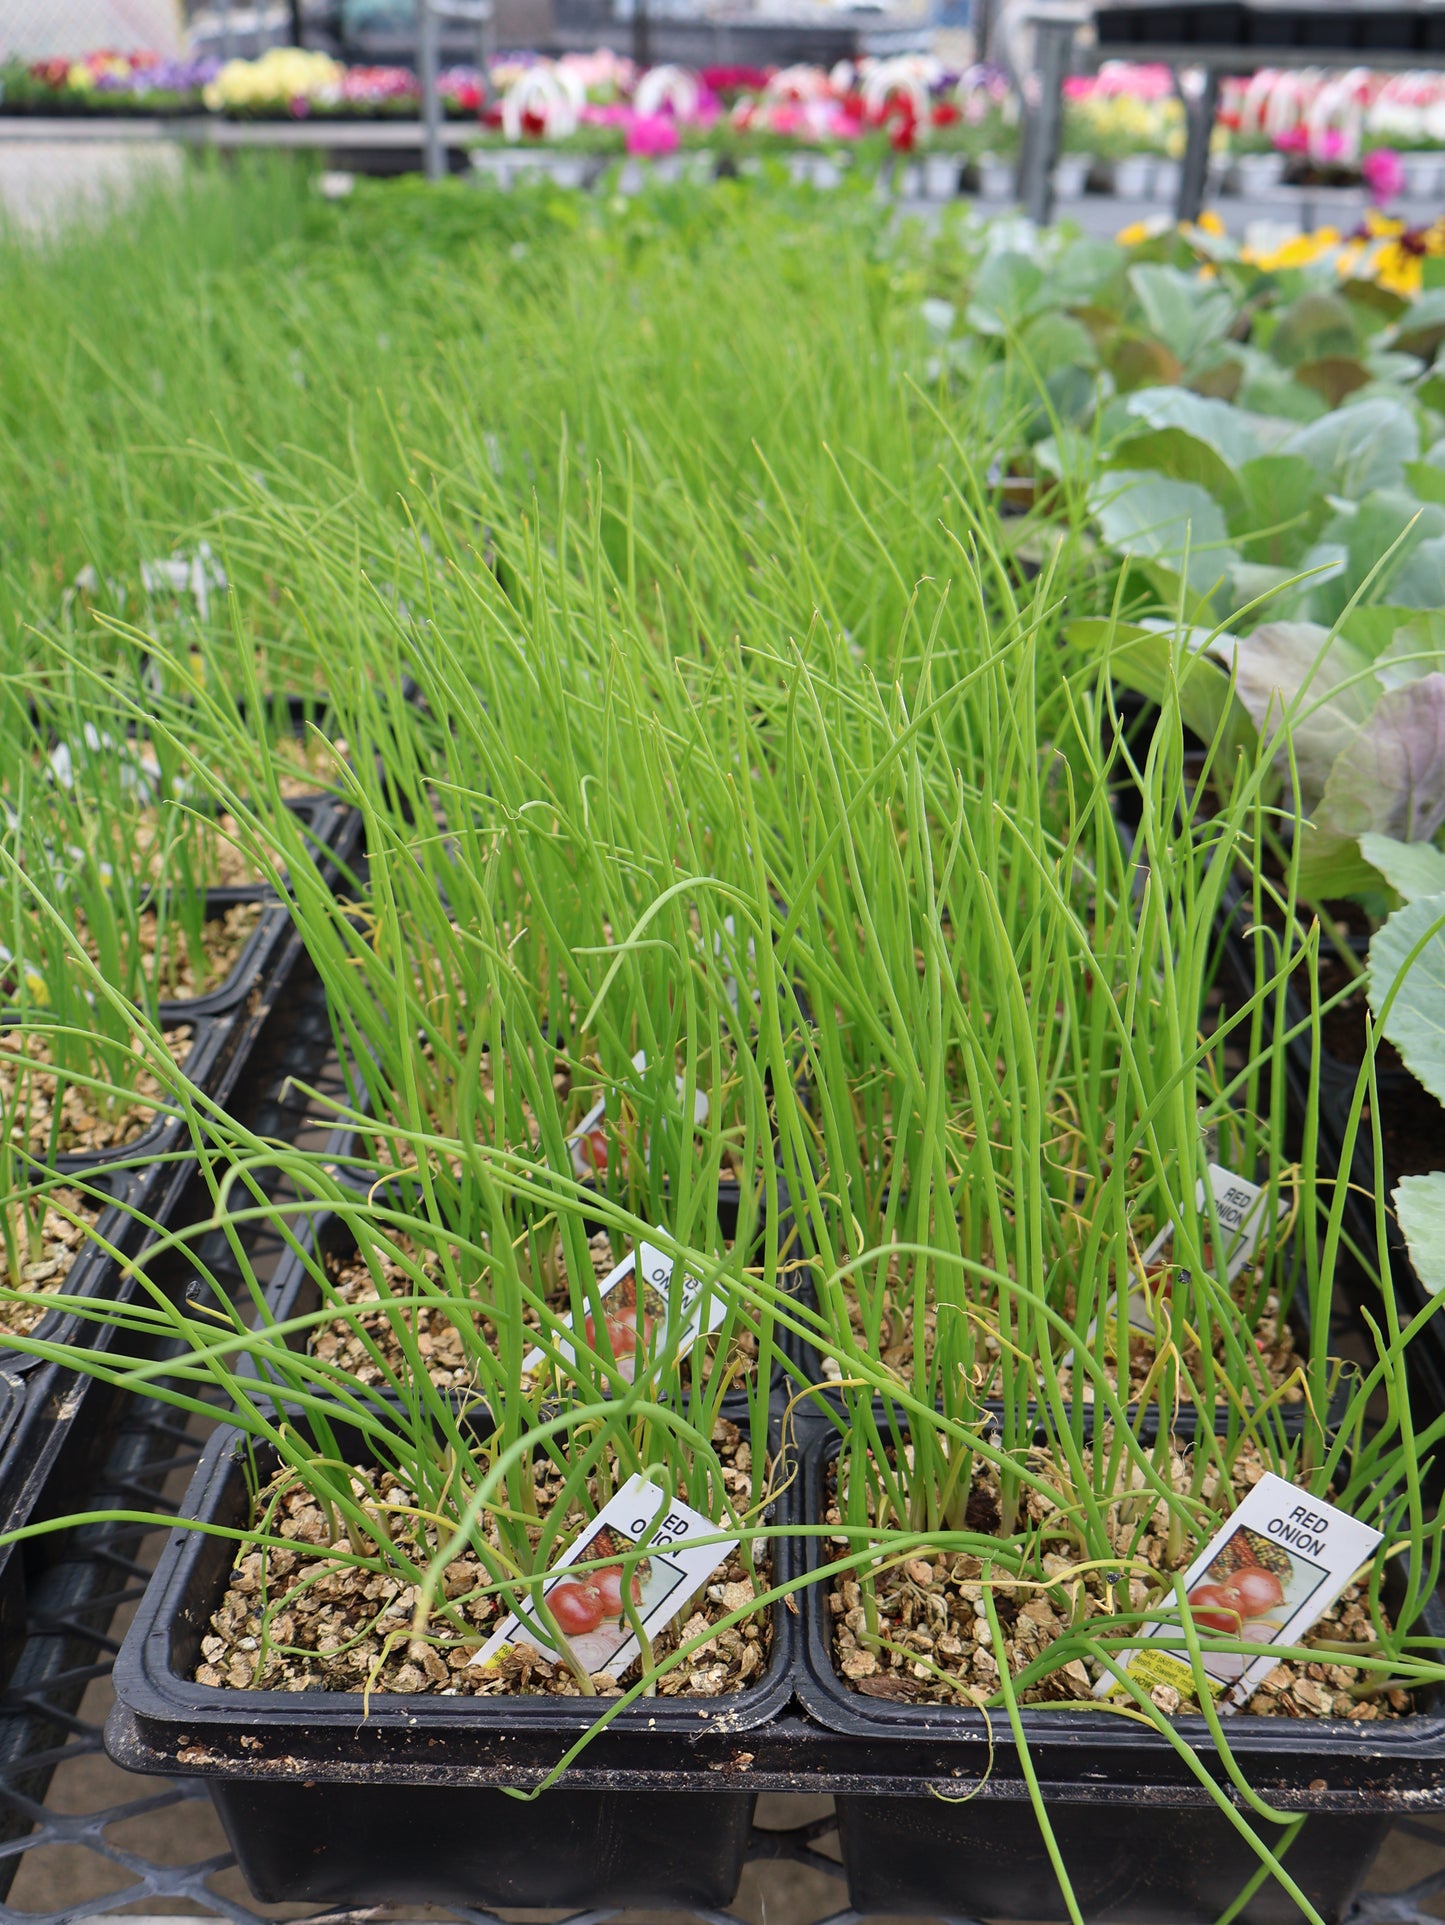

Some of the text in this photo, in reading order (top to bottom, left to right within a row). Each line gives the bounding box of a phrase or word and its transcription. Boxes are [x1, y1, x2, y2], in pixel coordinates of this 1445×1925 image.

[1223, 1187, 1251, 1208] RED
[1214, 1199, 1243, 1226] NION
[652, 1268, 693, 1309] ONN
[652, 1508, 689, 1535] ED
[1288, 1505, 1329, 1534] RED
[1267, 1518, 1326, 1557] ONION
